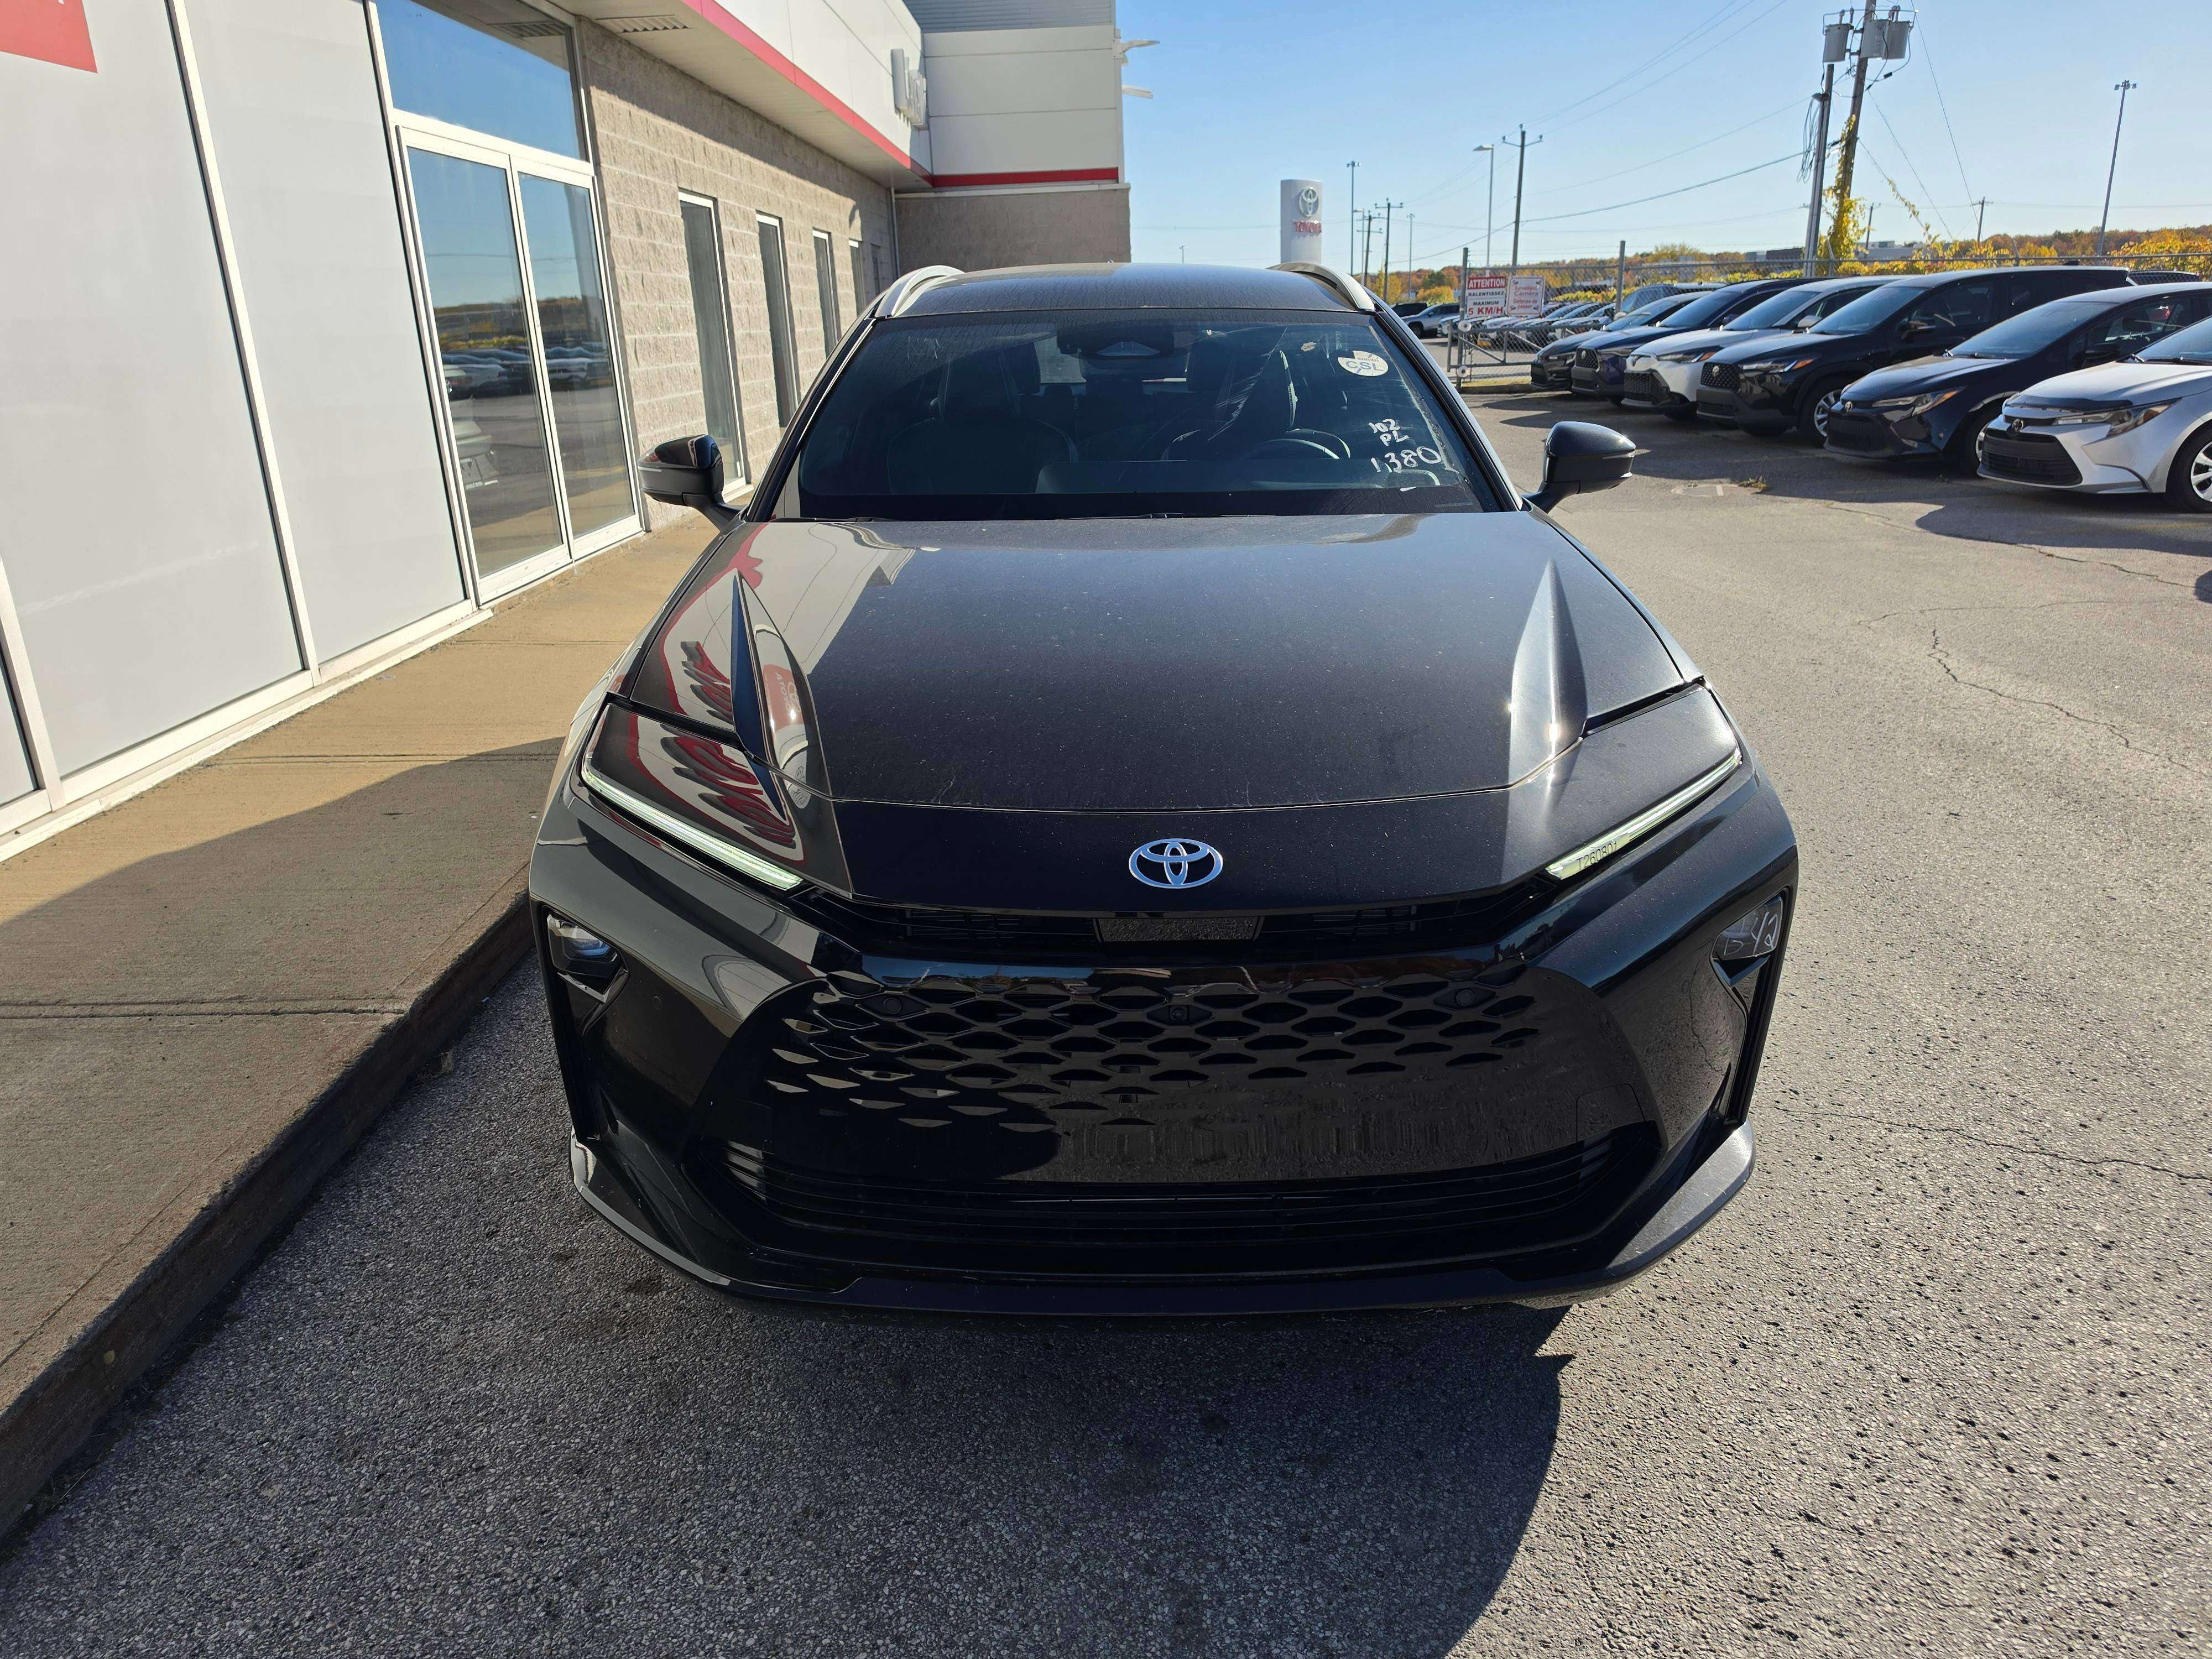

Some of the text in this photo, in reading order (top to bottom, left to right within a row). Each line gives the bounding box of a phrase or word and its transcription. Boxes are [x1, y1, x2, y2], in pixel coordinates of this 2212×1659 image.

[1293, 221, 1322, 233] TOYOTA
[1469, 278, 1505, 288] ATTENTION
[1478, 306, 1503, 315] KM/H
[1345, 361, 1384, 372] CSL
[1576, 841, 1617, 871] T260801
